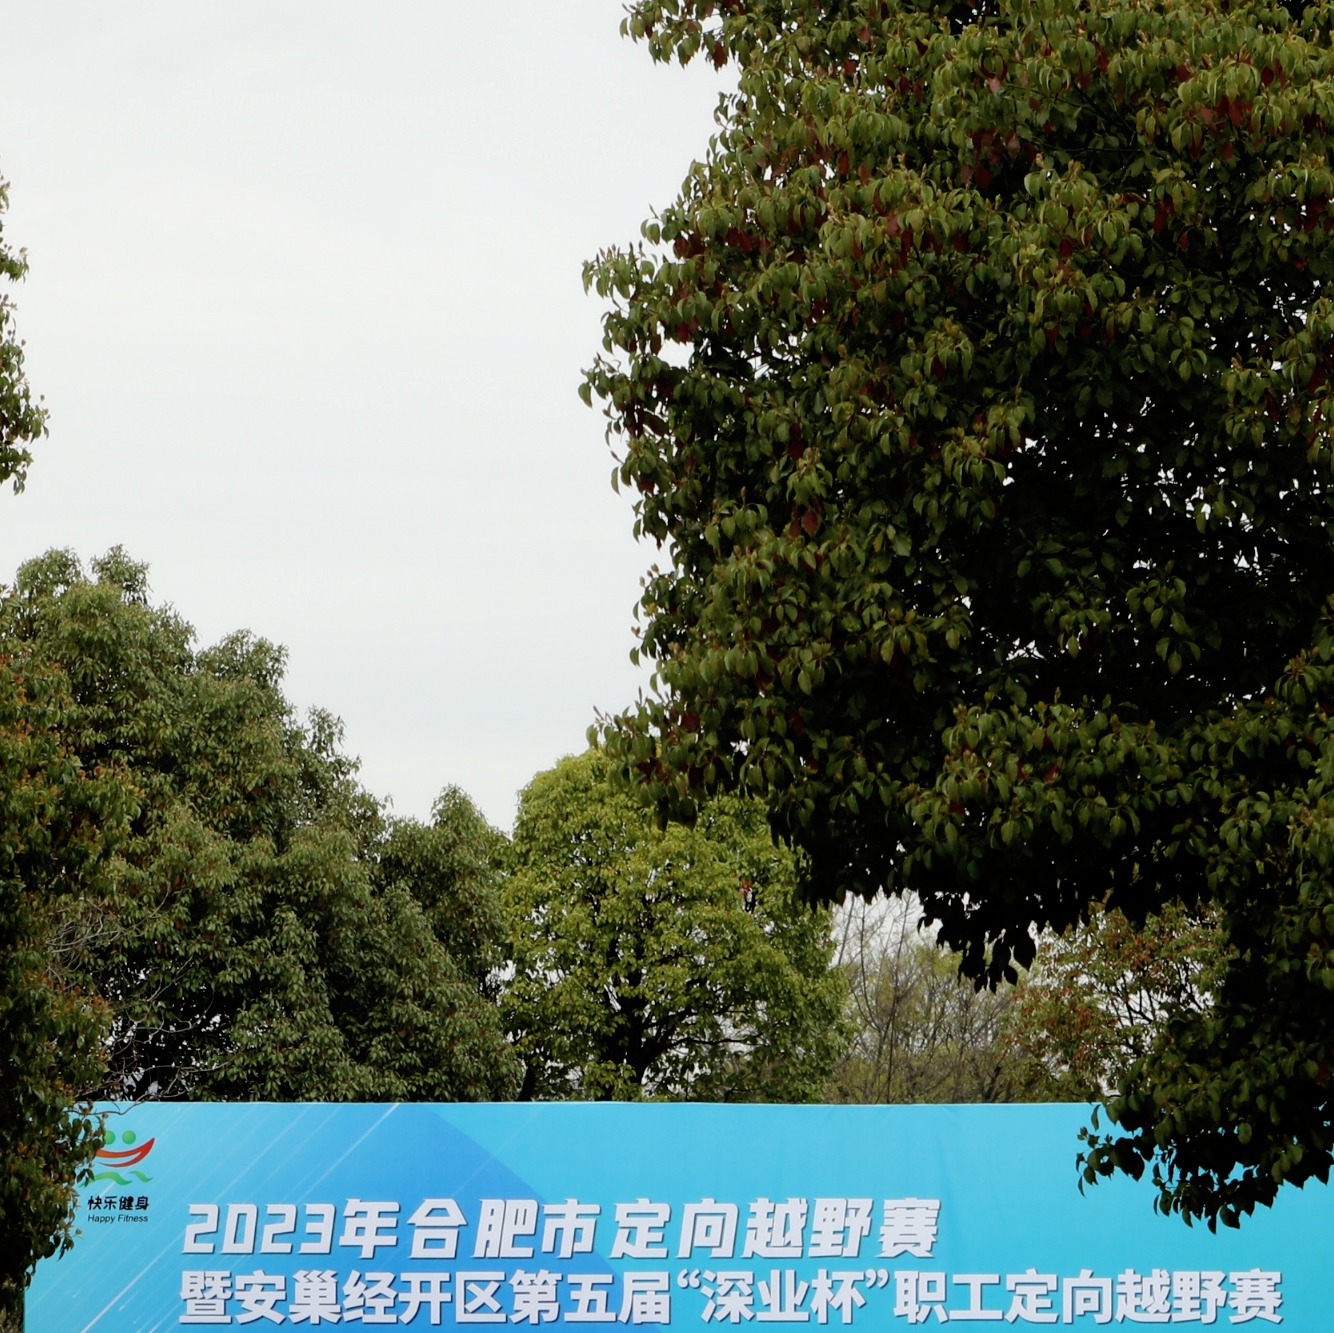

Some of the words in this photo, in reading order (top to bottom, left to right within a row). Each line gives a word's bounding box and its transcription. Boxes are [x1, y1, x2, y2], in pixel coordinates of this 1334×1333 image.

[87, 1195, 149, 1211] 快乐健身
[88, 1214, 116, 1224] Happy
[118, 1213, 149, 1223] Fitness
[182, 1197, 941, 1258] 2023年合肥市定向越野赛
[178, 1268, 1284, 1325] 暨安巢经开区第五届“深业杯”职工定向越野赛
